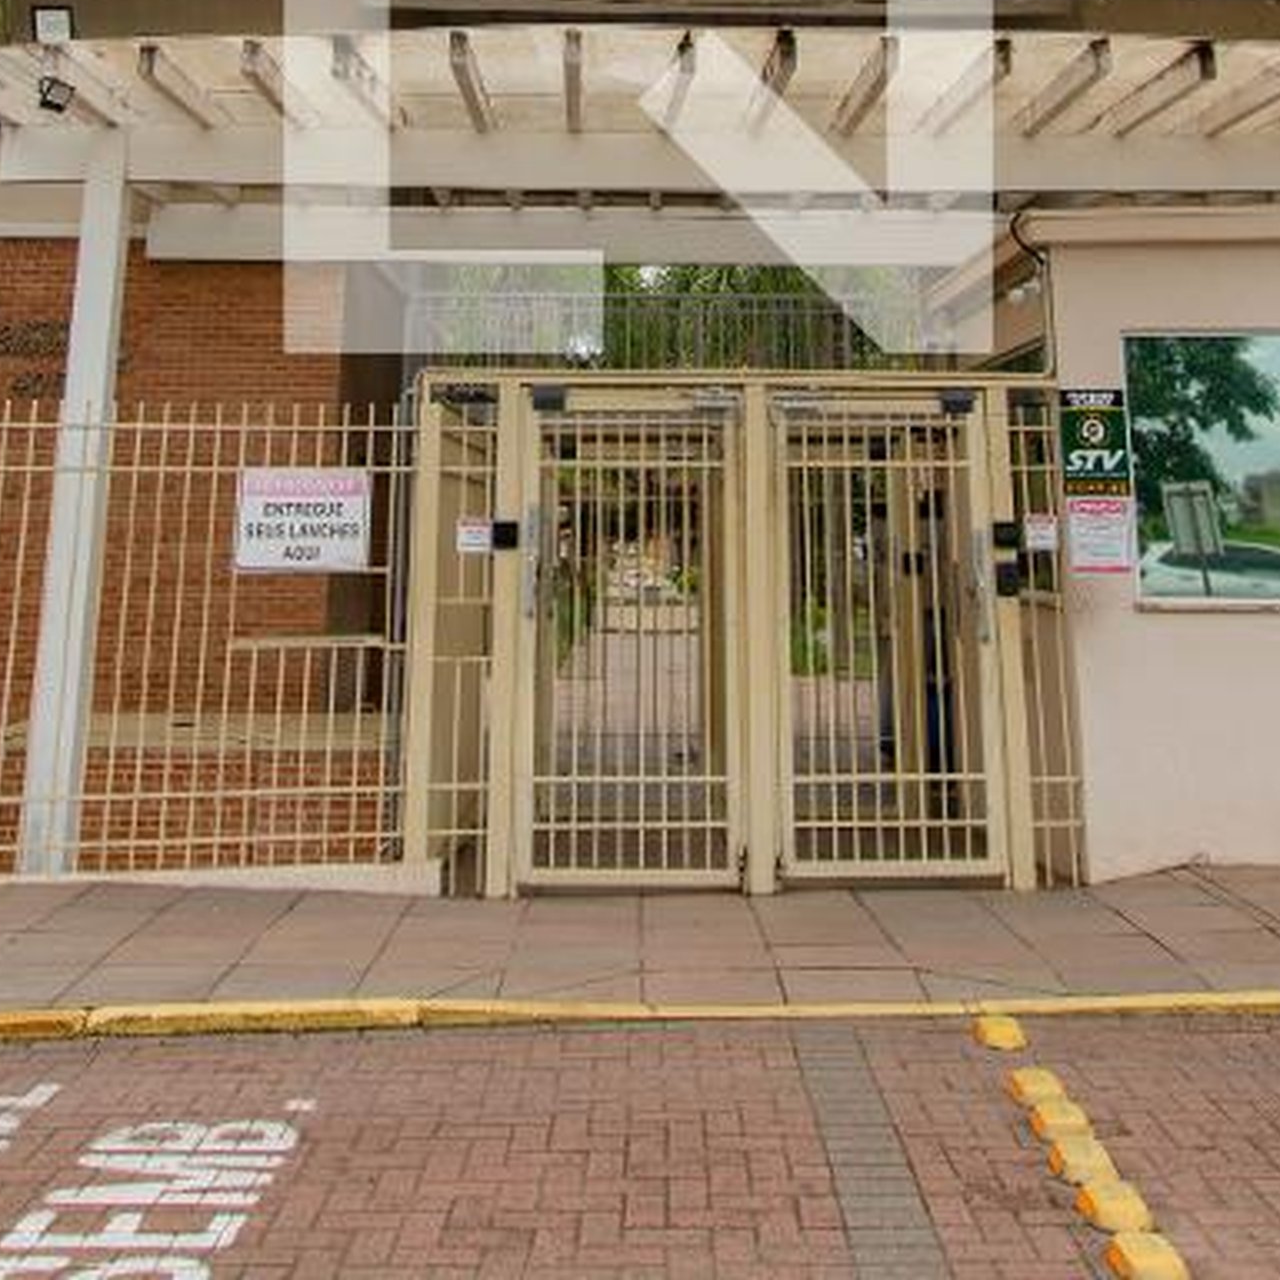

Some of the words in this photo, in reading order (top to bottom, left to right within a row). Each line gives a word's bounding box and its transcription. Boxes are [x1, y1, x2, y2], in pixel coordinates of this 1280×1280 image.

[1066, 449, 1125, 471] STV
[263, 502, 345, 517] ENTREGUE
[245, 522, 286, 538] SEUS
[289, 522, 360, 538] LANCHES
[283, 546, 321, 561] AQUI
